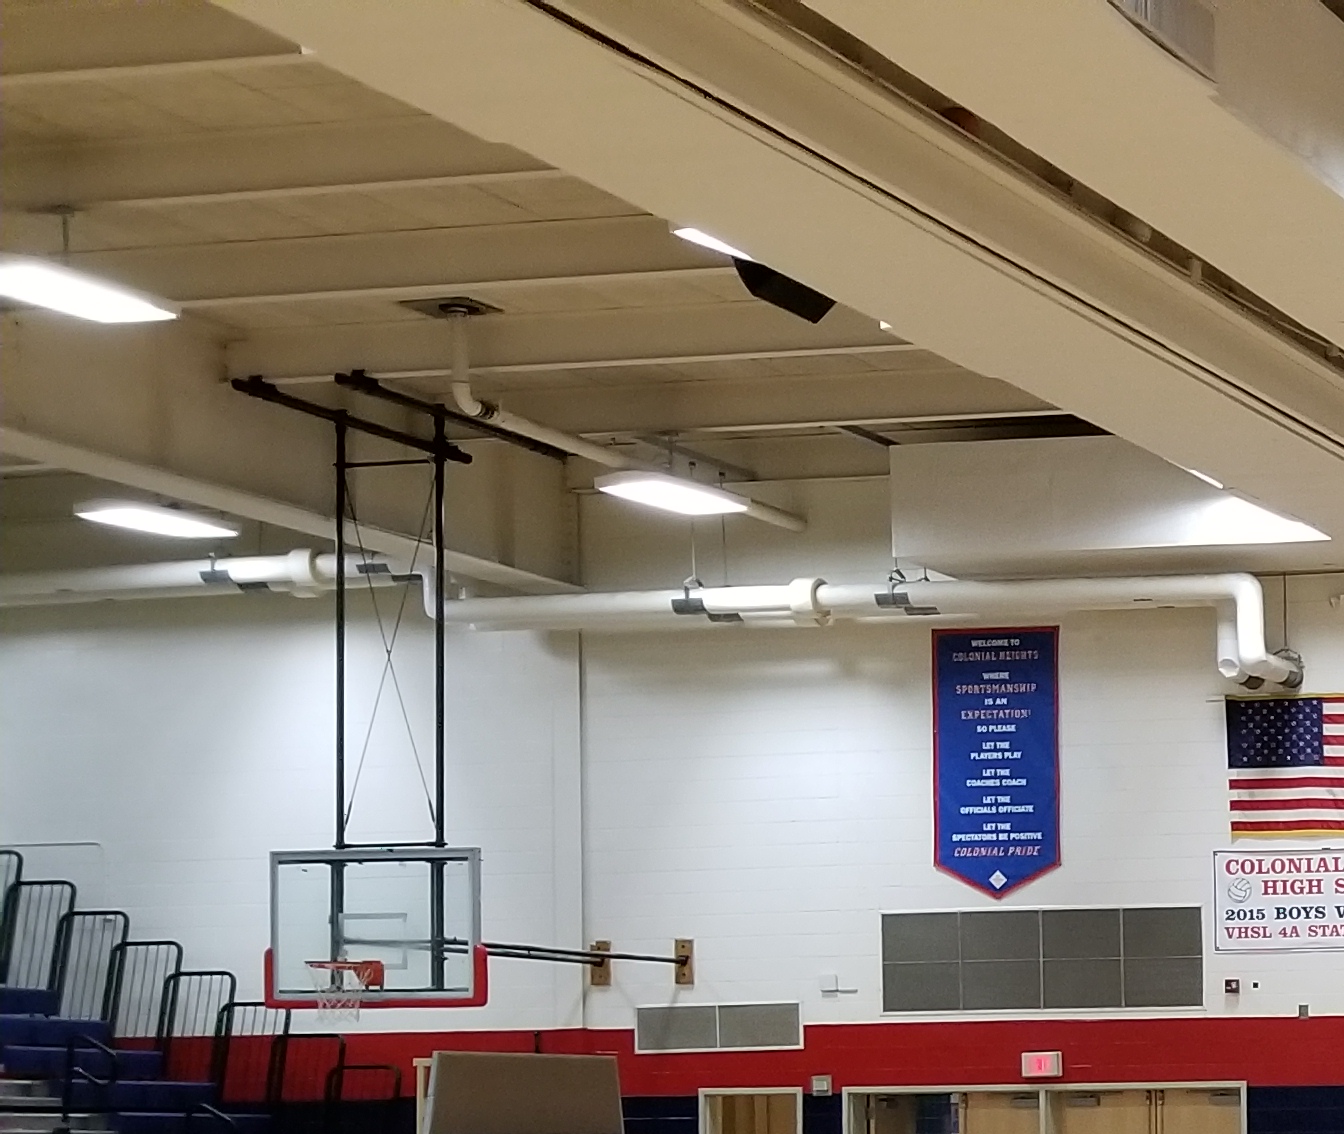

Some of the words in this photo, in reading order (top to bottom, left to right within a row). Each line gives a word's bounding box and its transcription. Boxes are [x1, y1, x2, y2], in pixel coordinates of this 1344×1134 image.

[971, 639, 1008, 647] WELCOME
[953, 652, 996, 662] COLONIAL
[999, 650, 1038, 660] HEIGHTS
[956, 684, 1036, 694] SPORTSMANSHIP
[989, 724, 1016, 732] PLEASE
[996, 741, 1010, 749] THE
[970, 752, 1002, 760] PLAYERS
[1004, 751, 1022, 759] PLAY
[952, 833, 996, 841] SPECTATORS
[1010, 832, 1042, 840] POSITIVE
[954, 847, 1004, 857] COLONIAL
[1008, 846, 1041, 856] PRIDE
[1262, 878, 1324, 896] HIGH
[1225, 908, 1266, 921] 2015
[1274, 906, 1326, 920] BOYS
[1225, 926, 1272, 939] VHSL
[1278, 925, 1300, 938] 4A
